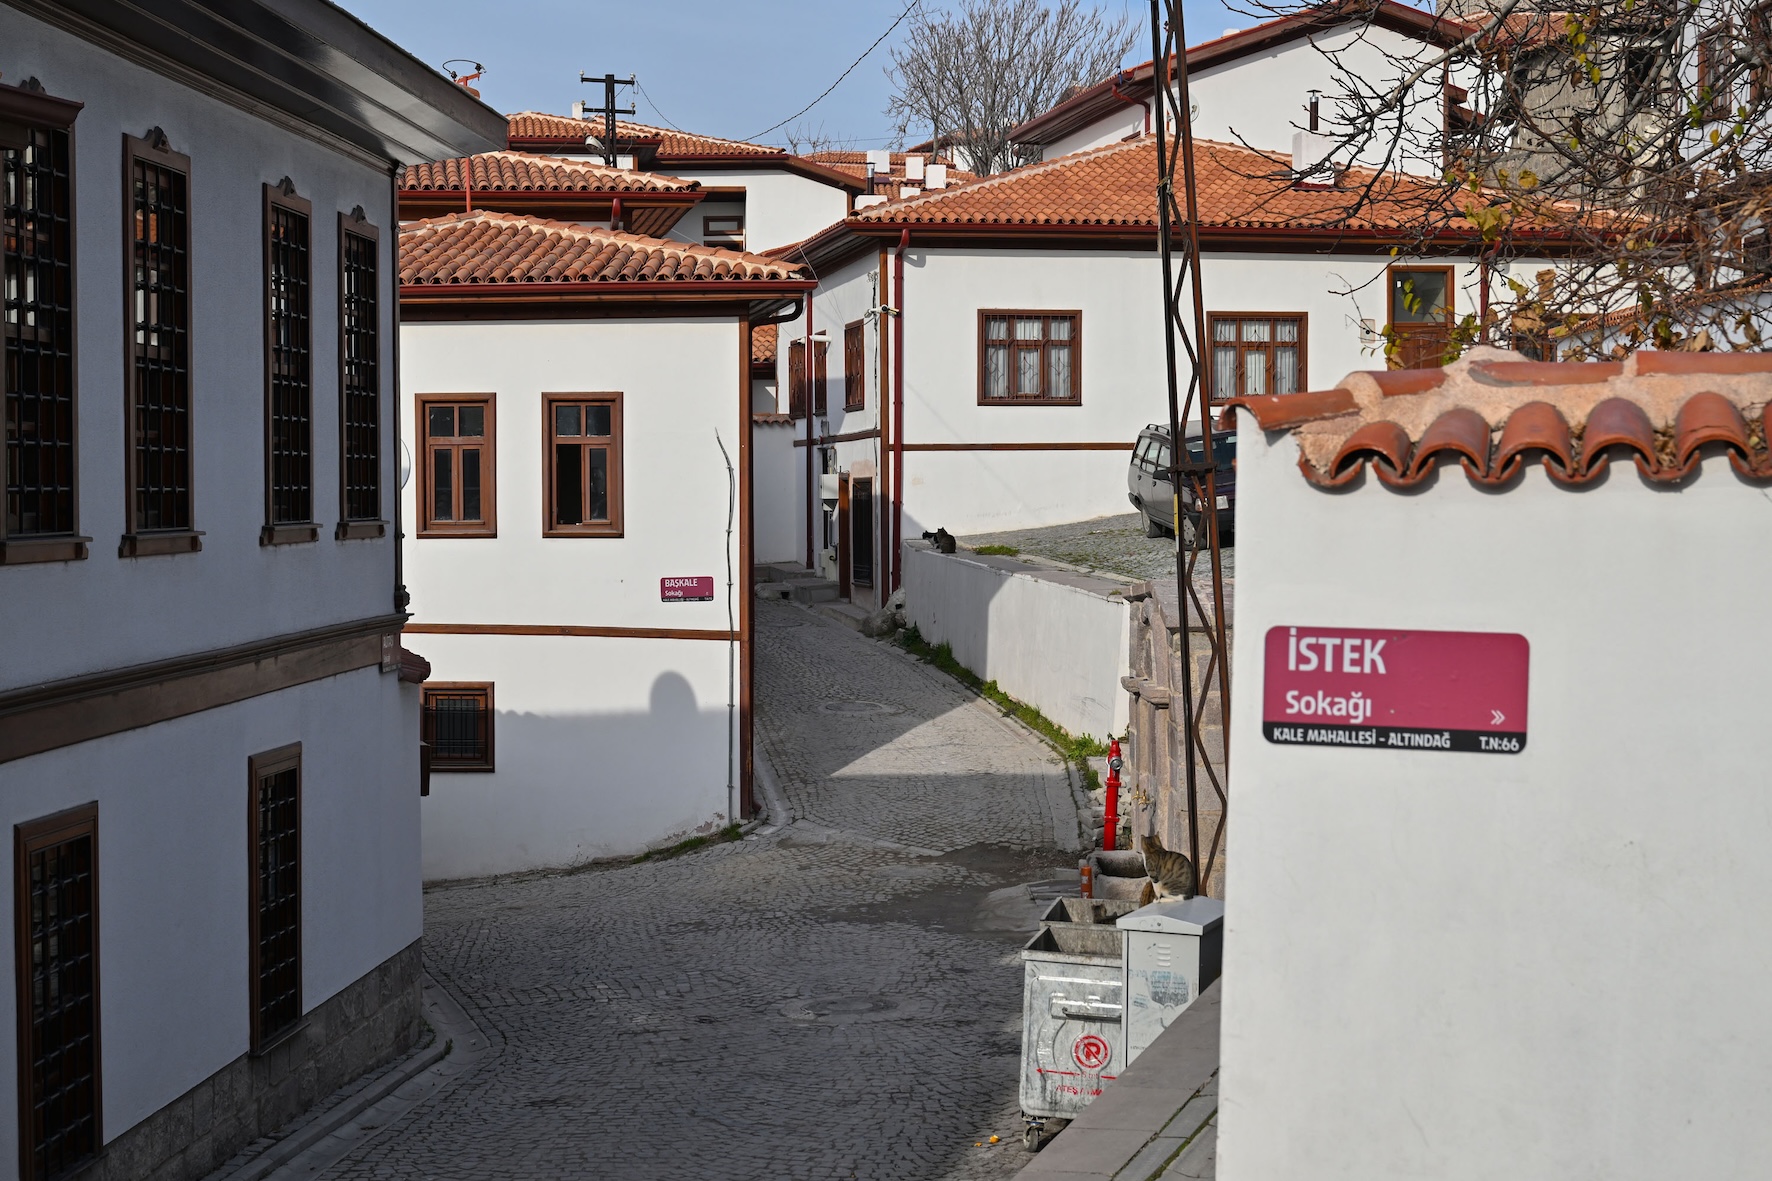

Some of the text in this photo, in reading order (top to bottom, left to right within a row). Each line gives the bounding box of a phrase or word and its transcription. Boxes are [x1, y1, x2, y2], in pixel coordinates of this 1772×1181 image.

[665, 578, 697, 587] BAŞKALE
[1287, 627, 1387, 675] İSTEK
[1285, 690, 1372, 724] Sokağı
[1273, 727, 1304, 742] KALE
[1306, 728, 1377, 745] MAHALLESİ
[1388, 731, 1451, 749] ALTINDAĞ
[1479, 736, 1520, 752] T.N:66
